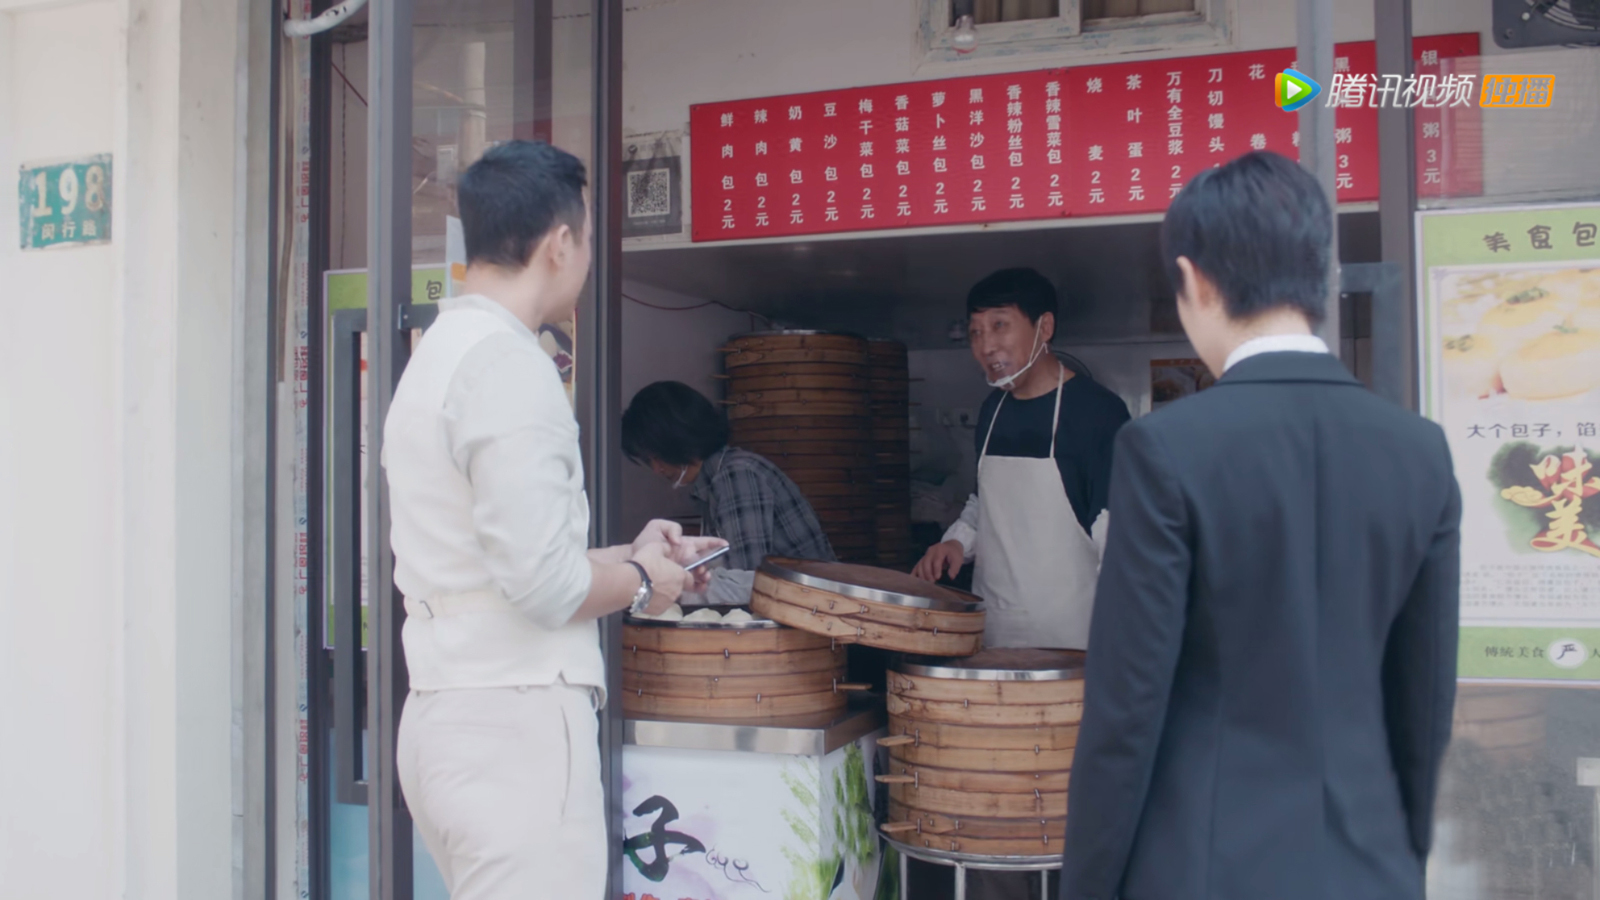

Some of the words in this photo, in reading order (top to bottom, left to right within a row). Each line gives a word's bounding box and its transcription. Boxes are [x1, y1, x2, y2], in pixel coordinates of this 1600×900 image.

[1207, 68, 1225, 168] 刀切馒头
[32, 164, 104, 218] 198
[1483, 221, 1598, 252] 美食包
[1467, 422, 1600, 439] 大个包子，馅
